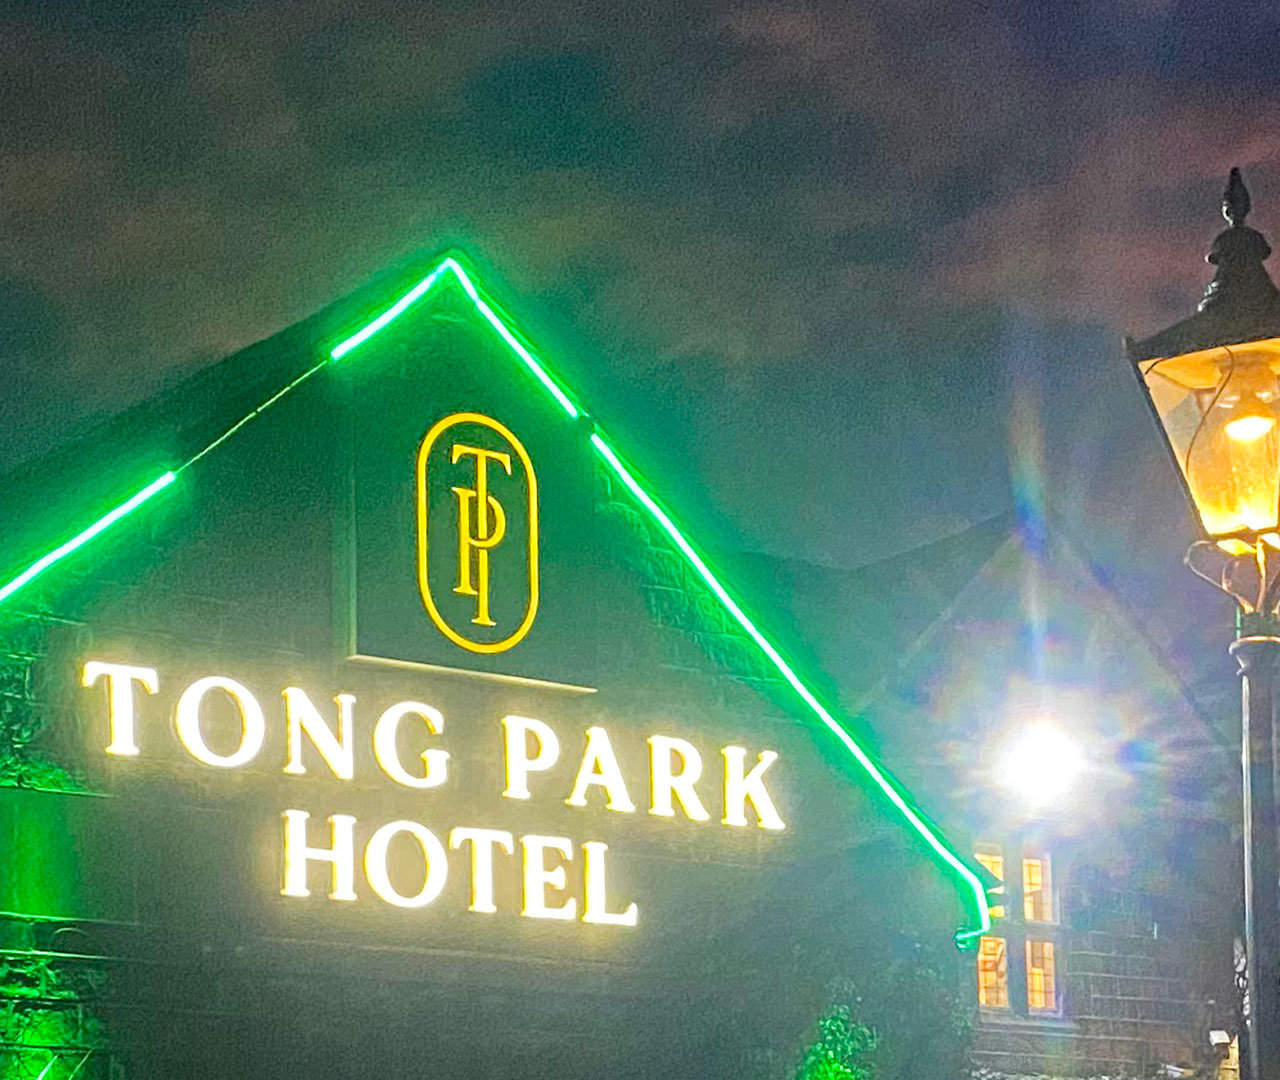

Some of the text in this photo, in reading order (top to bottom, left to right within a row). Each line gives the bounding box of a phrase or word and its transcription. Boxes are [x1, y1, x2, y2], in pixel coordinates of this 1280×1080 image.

[81, 660, 787, 831] TONG PARK
[280, 809, 639, 927] HOTEL
